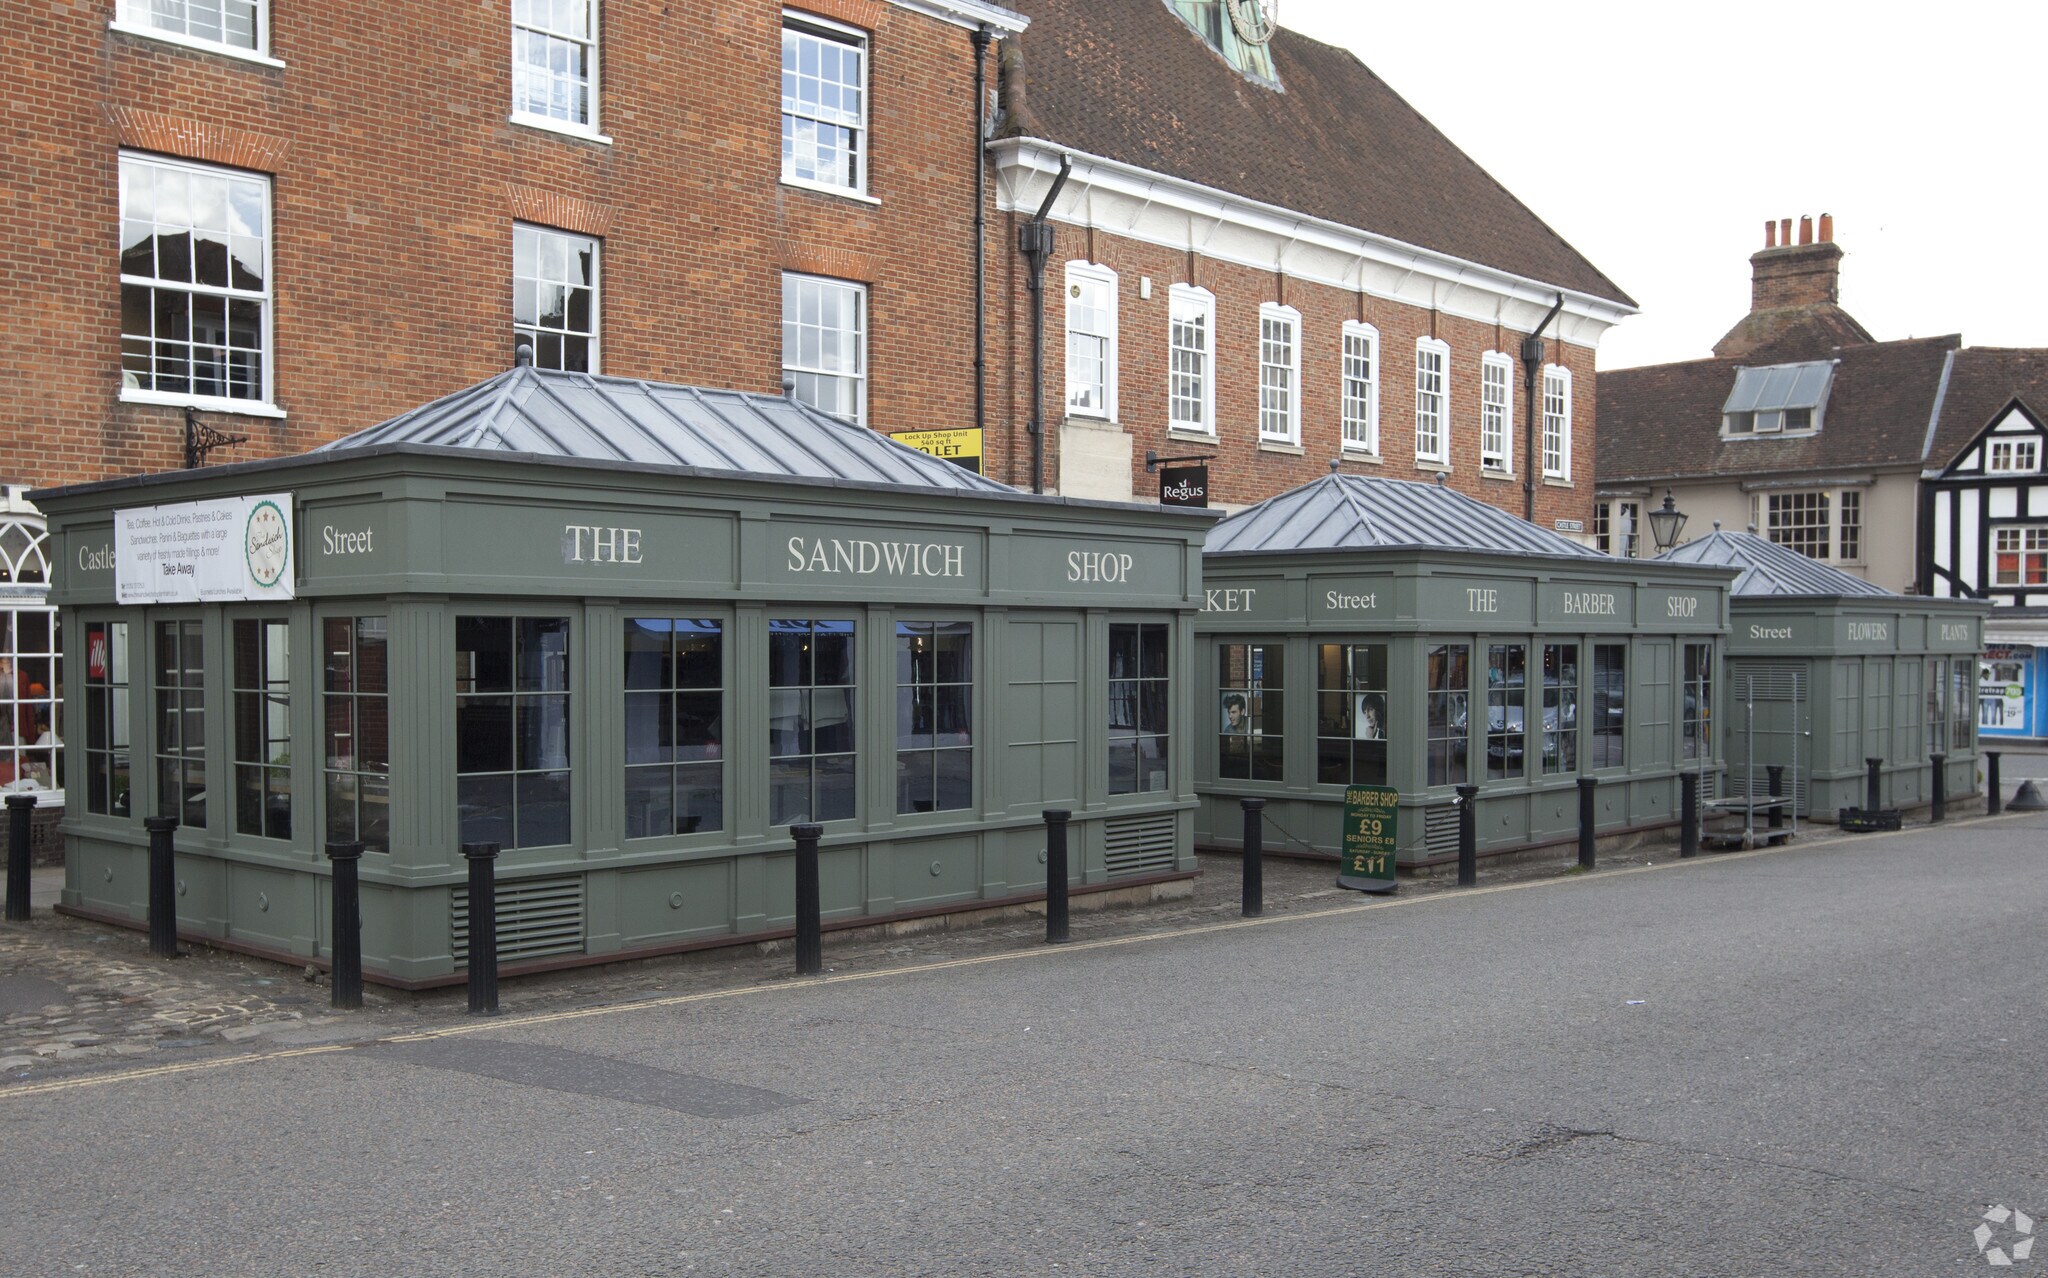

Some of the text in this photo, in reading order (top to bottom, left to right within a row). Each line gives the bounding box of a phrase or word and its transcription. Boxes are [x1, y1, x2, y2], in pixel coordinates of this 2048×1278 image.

[933, 432, 951, 440] Shop
[914, 445, 961, 456] O LET
[1164, 486, 1203, 500] Regus
[166, 515, 176, 526] Cold
[216, 510, 232, 521] Cakes
[177, 531, 200, 543] Baguettes
[215, 529, 228, 541] large
[249, 526, 282, 554] Sandwich
[79, 525, 373, 571] Castle Street
[137, 551, 151, 563] variety
[172, 548, 185, 558] made
[565, 525, 1133, 582] THE SANDWICH SHOP
[162, 562, 195, 578] Take Away
[1200, 588, 1377, 612] KET Street
[1467, 588, 1698, 617] THE BARBER SHOP
[1750, 624, 1792, 639] Street
[1848, 623, 1968, 641] FLOWERS PLANTS
[91, 639, 106, 674] illy
[1353, 791, 1379, 806] BARBER
[1380, 792, 1398, 807] SHOP
[1360, 819, 1382, 836] £9
[1346, 834, 1383, 844] SENIORS
